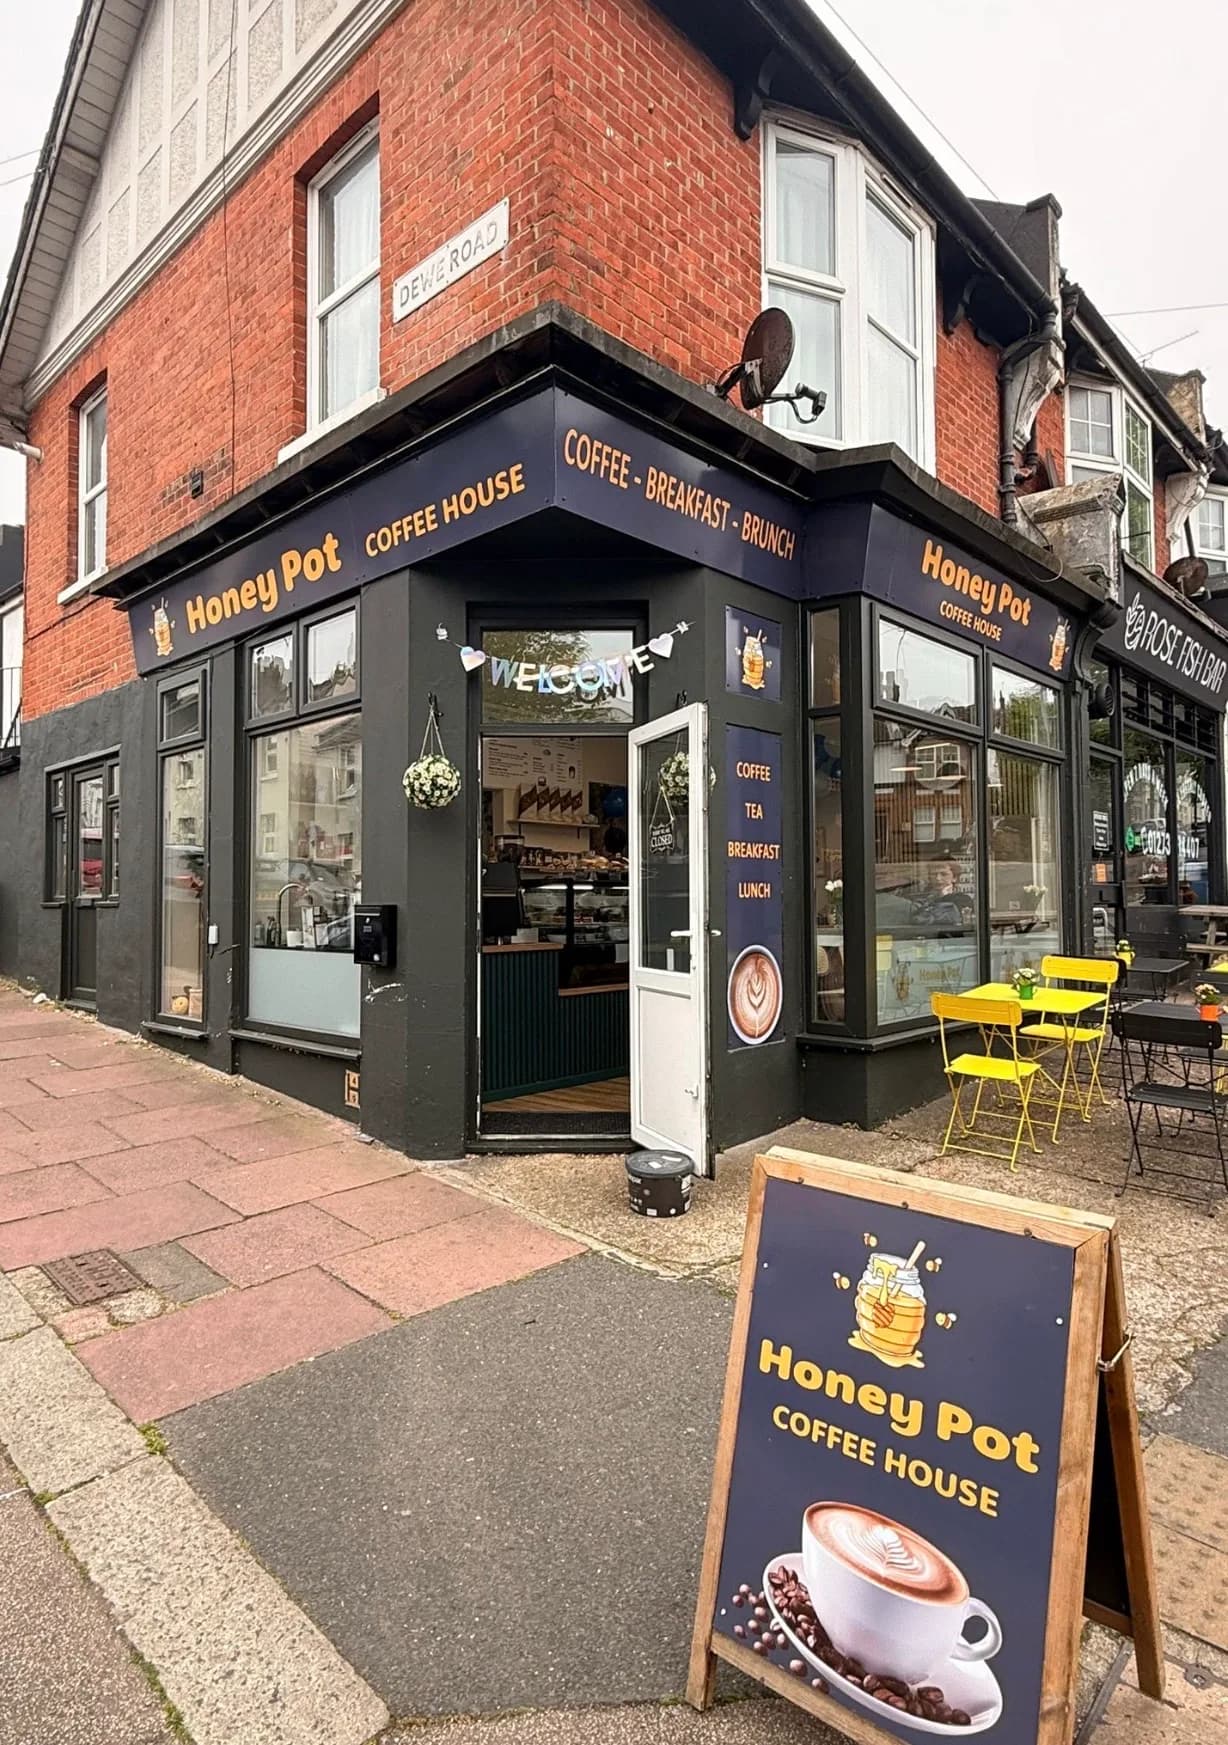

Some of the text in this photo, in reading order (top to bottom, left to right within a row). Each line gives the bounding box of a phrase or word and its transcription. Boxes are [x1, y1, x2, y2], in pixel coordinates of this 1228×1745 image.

[400, 221, 498, 308] DEWE ROAD
[564, 428, 632, 489] COFFEE
[645, 466, 731, 532] BREAKFAST
[741, 511, 797, 561] BRUNCH
[186, 463, 526, 634] Honey Pot COFFEE HOUSE
[922, 539, 1032, 626] Honey Pot
[940, 600, 1002, 641] COFFEE HOUSE
[1140, 611, 1227, 694] ROSE FISH BAR
[490, 645, 655, 695] WELCOME
[736, 761, 771, 783] COFFEE
[651, 833, 673, 848] CLOSED
[745, 802, 763, 820] TEA
[727, 841, 780, 860] BREAKFAST
[738, 882, 771, 899] LUNCH
[759, 1338, 1040, 1474] Honey Pot
[772, 1405, 999, 1518] COFFEE HOUSE
